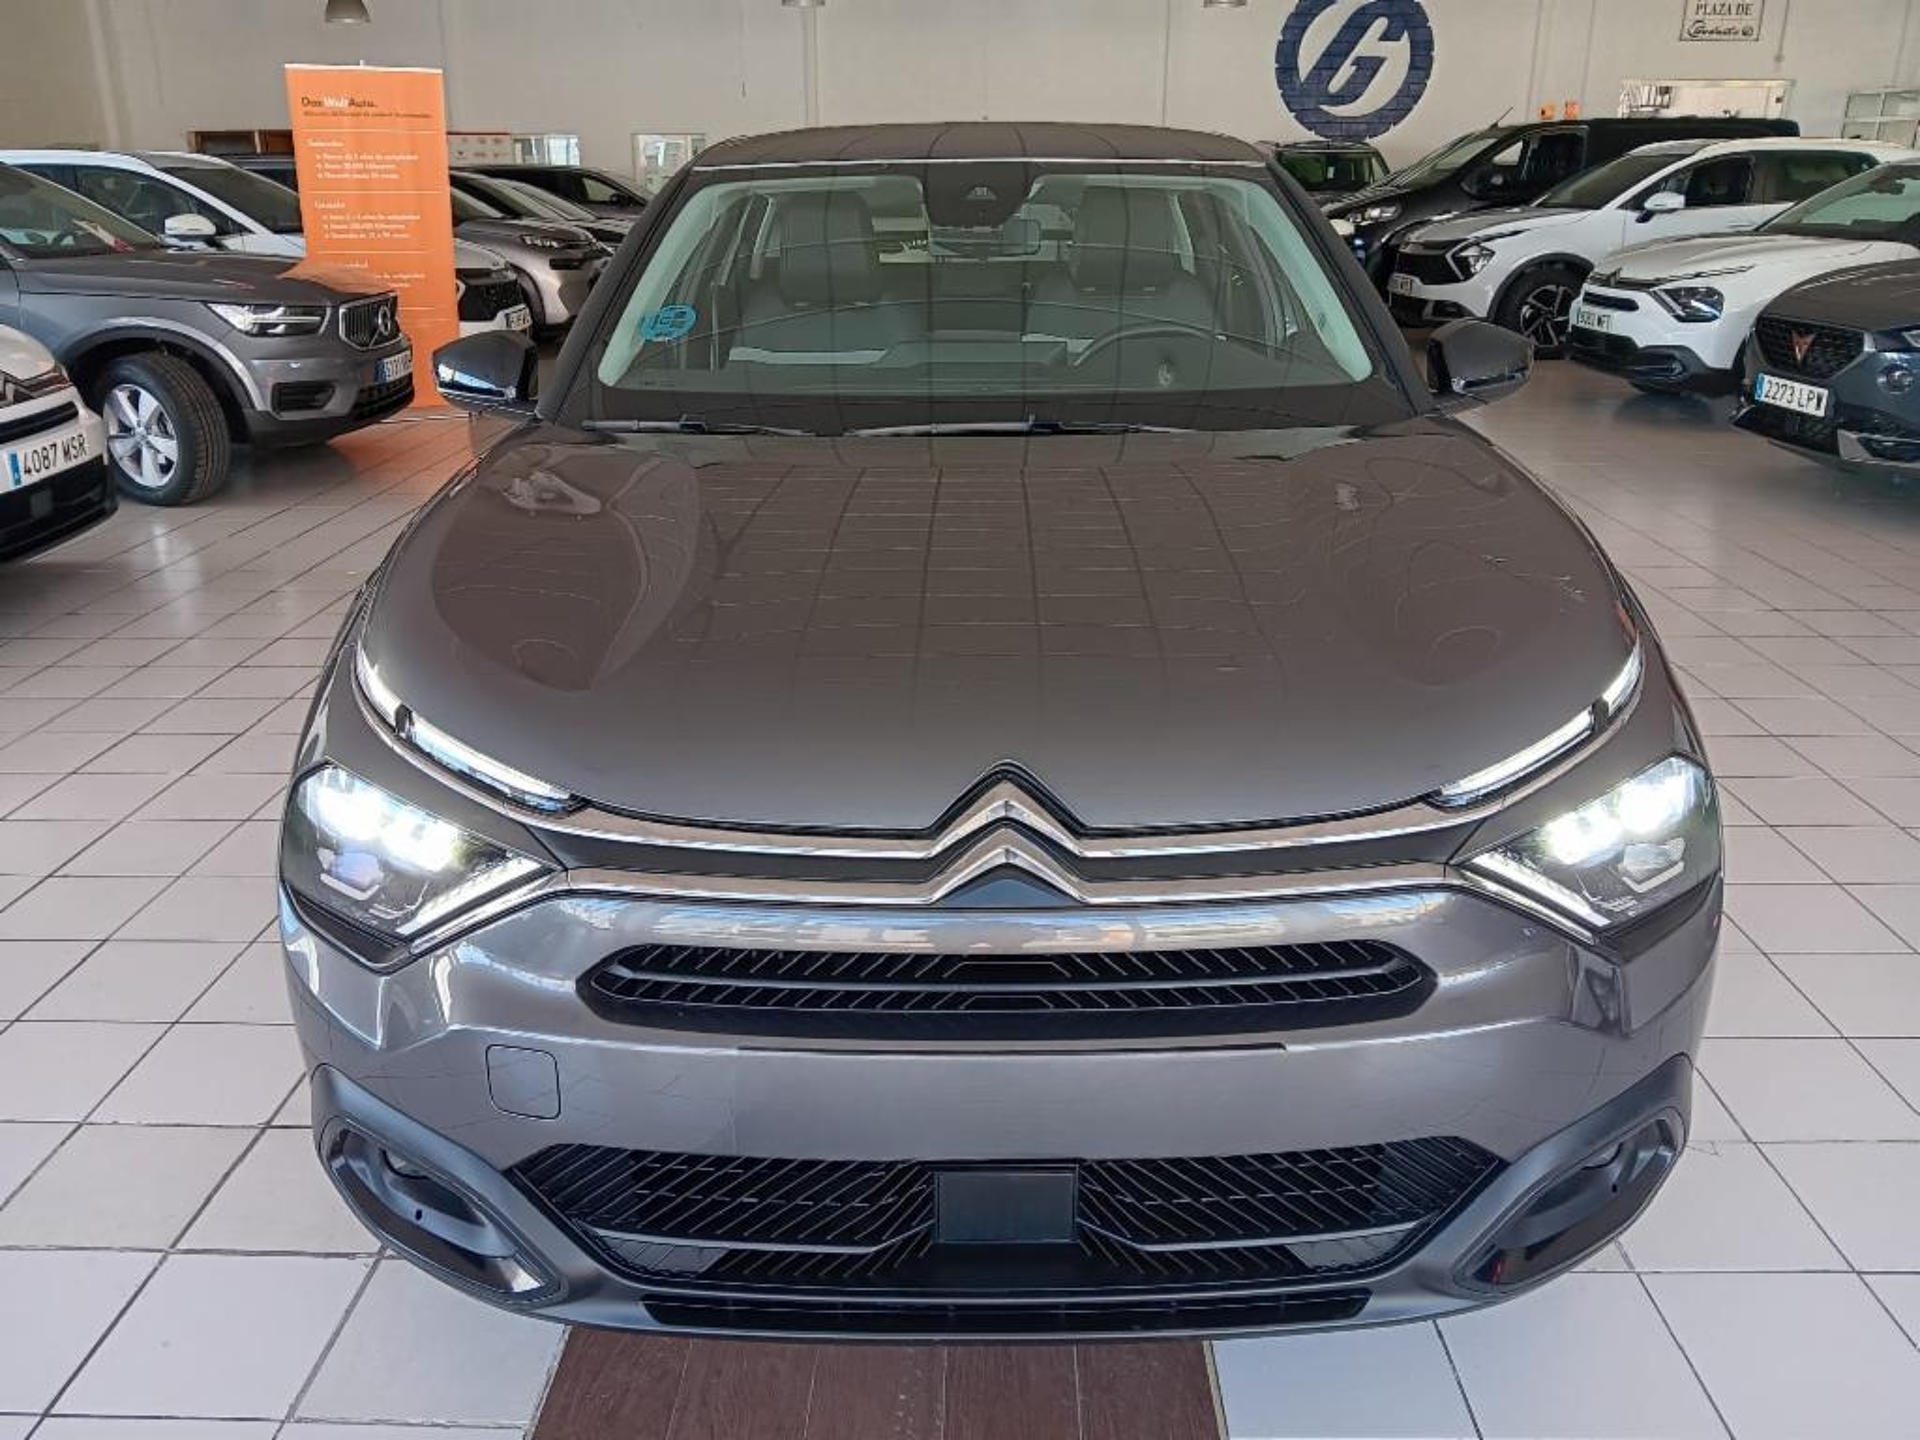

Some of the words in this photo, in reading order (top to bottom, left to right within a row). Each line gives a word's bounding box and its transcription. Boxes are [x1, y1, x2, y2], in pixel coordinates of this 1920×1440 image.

[1694, 3, 1732, 16] PLAZA
[1735, 3, 1754, 16] DE
[1764, 379, 1796, 404] 2273
[23, 442, 58, 475] 4087
